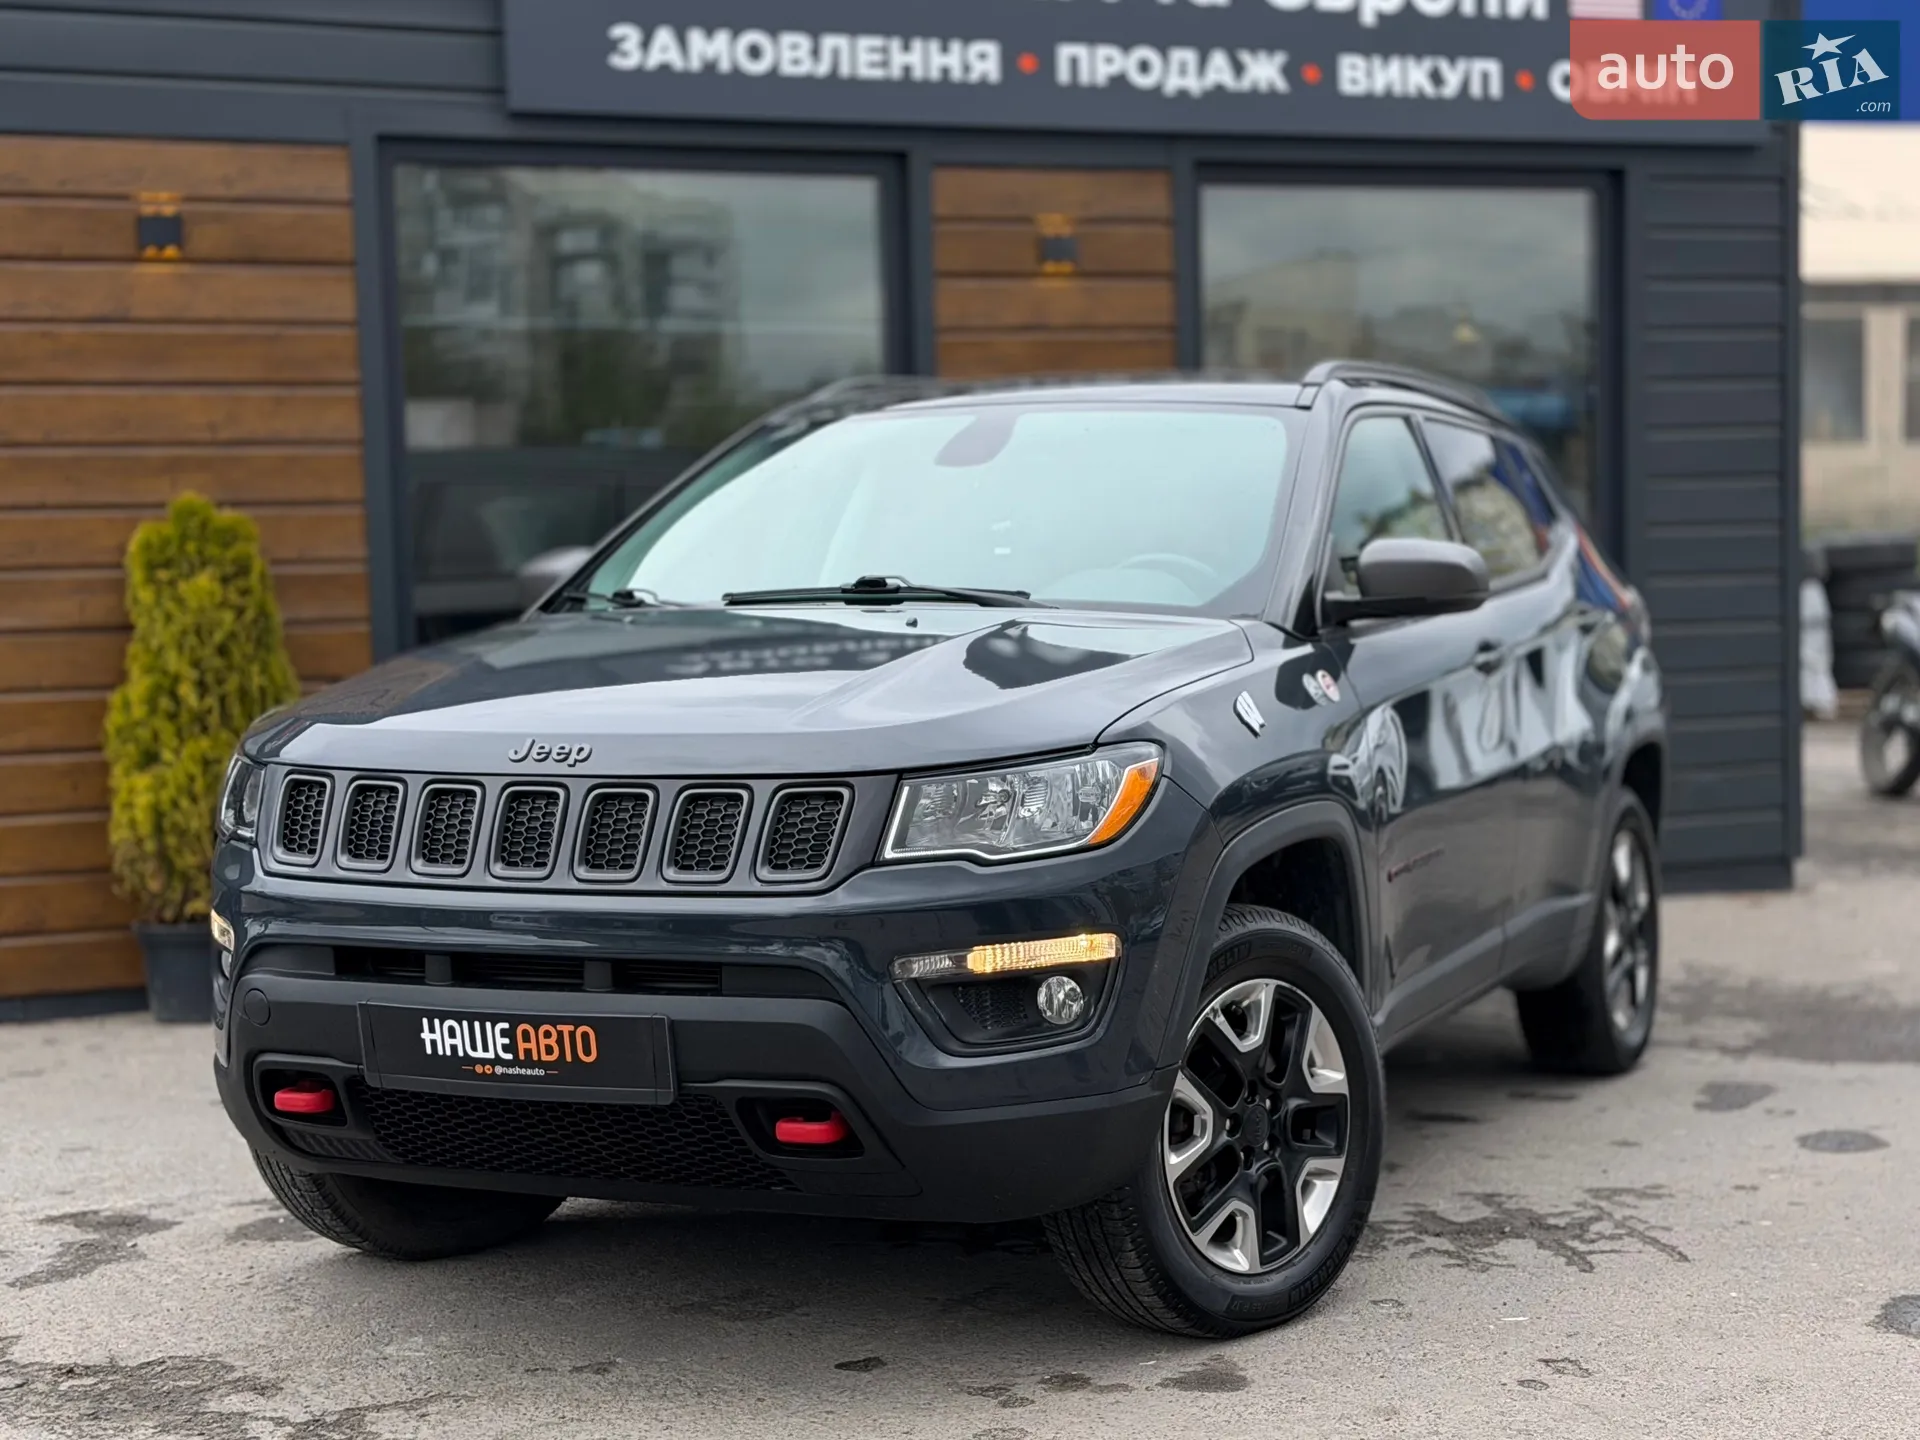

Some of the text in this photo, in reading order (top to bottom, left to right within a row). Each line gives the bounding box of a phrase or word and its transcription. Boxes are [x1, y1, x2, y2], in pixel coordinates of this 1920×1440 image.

[607, 23, 1001, 83] ЗАМОВЛЕННЯ
[1055, 42, 1290, 97] ПРОДАЖ
[1337, 52, 1502, 100] ВИКУП
[508, 738, 592, 768] Jeep
[421, 1017, 597, 1063] НАШЕ АВТО
[494, 1065, 545, 1076] @nasheauto
